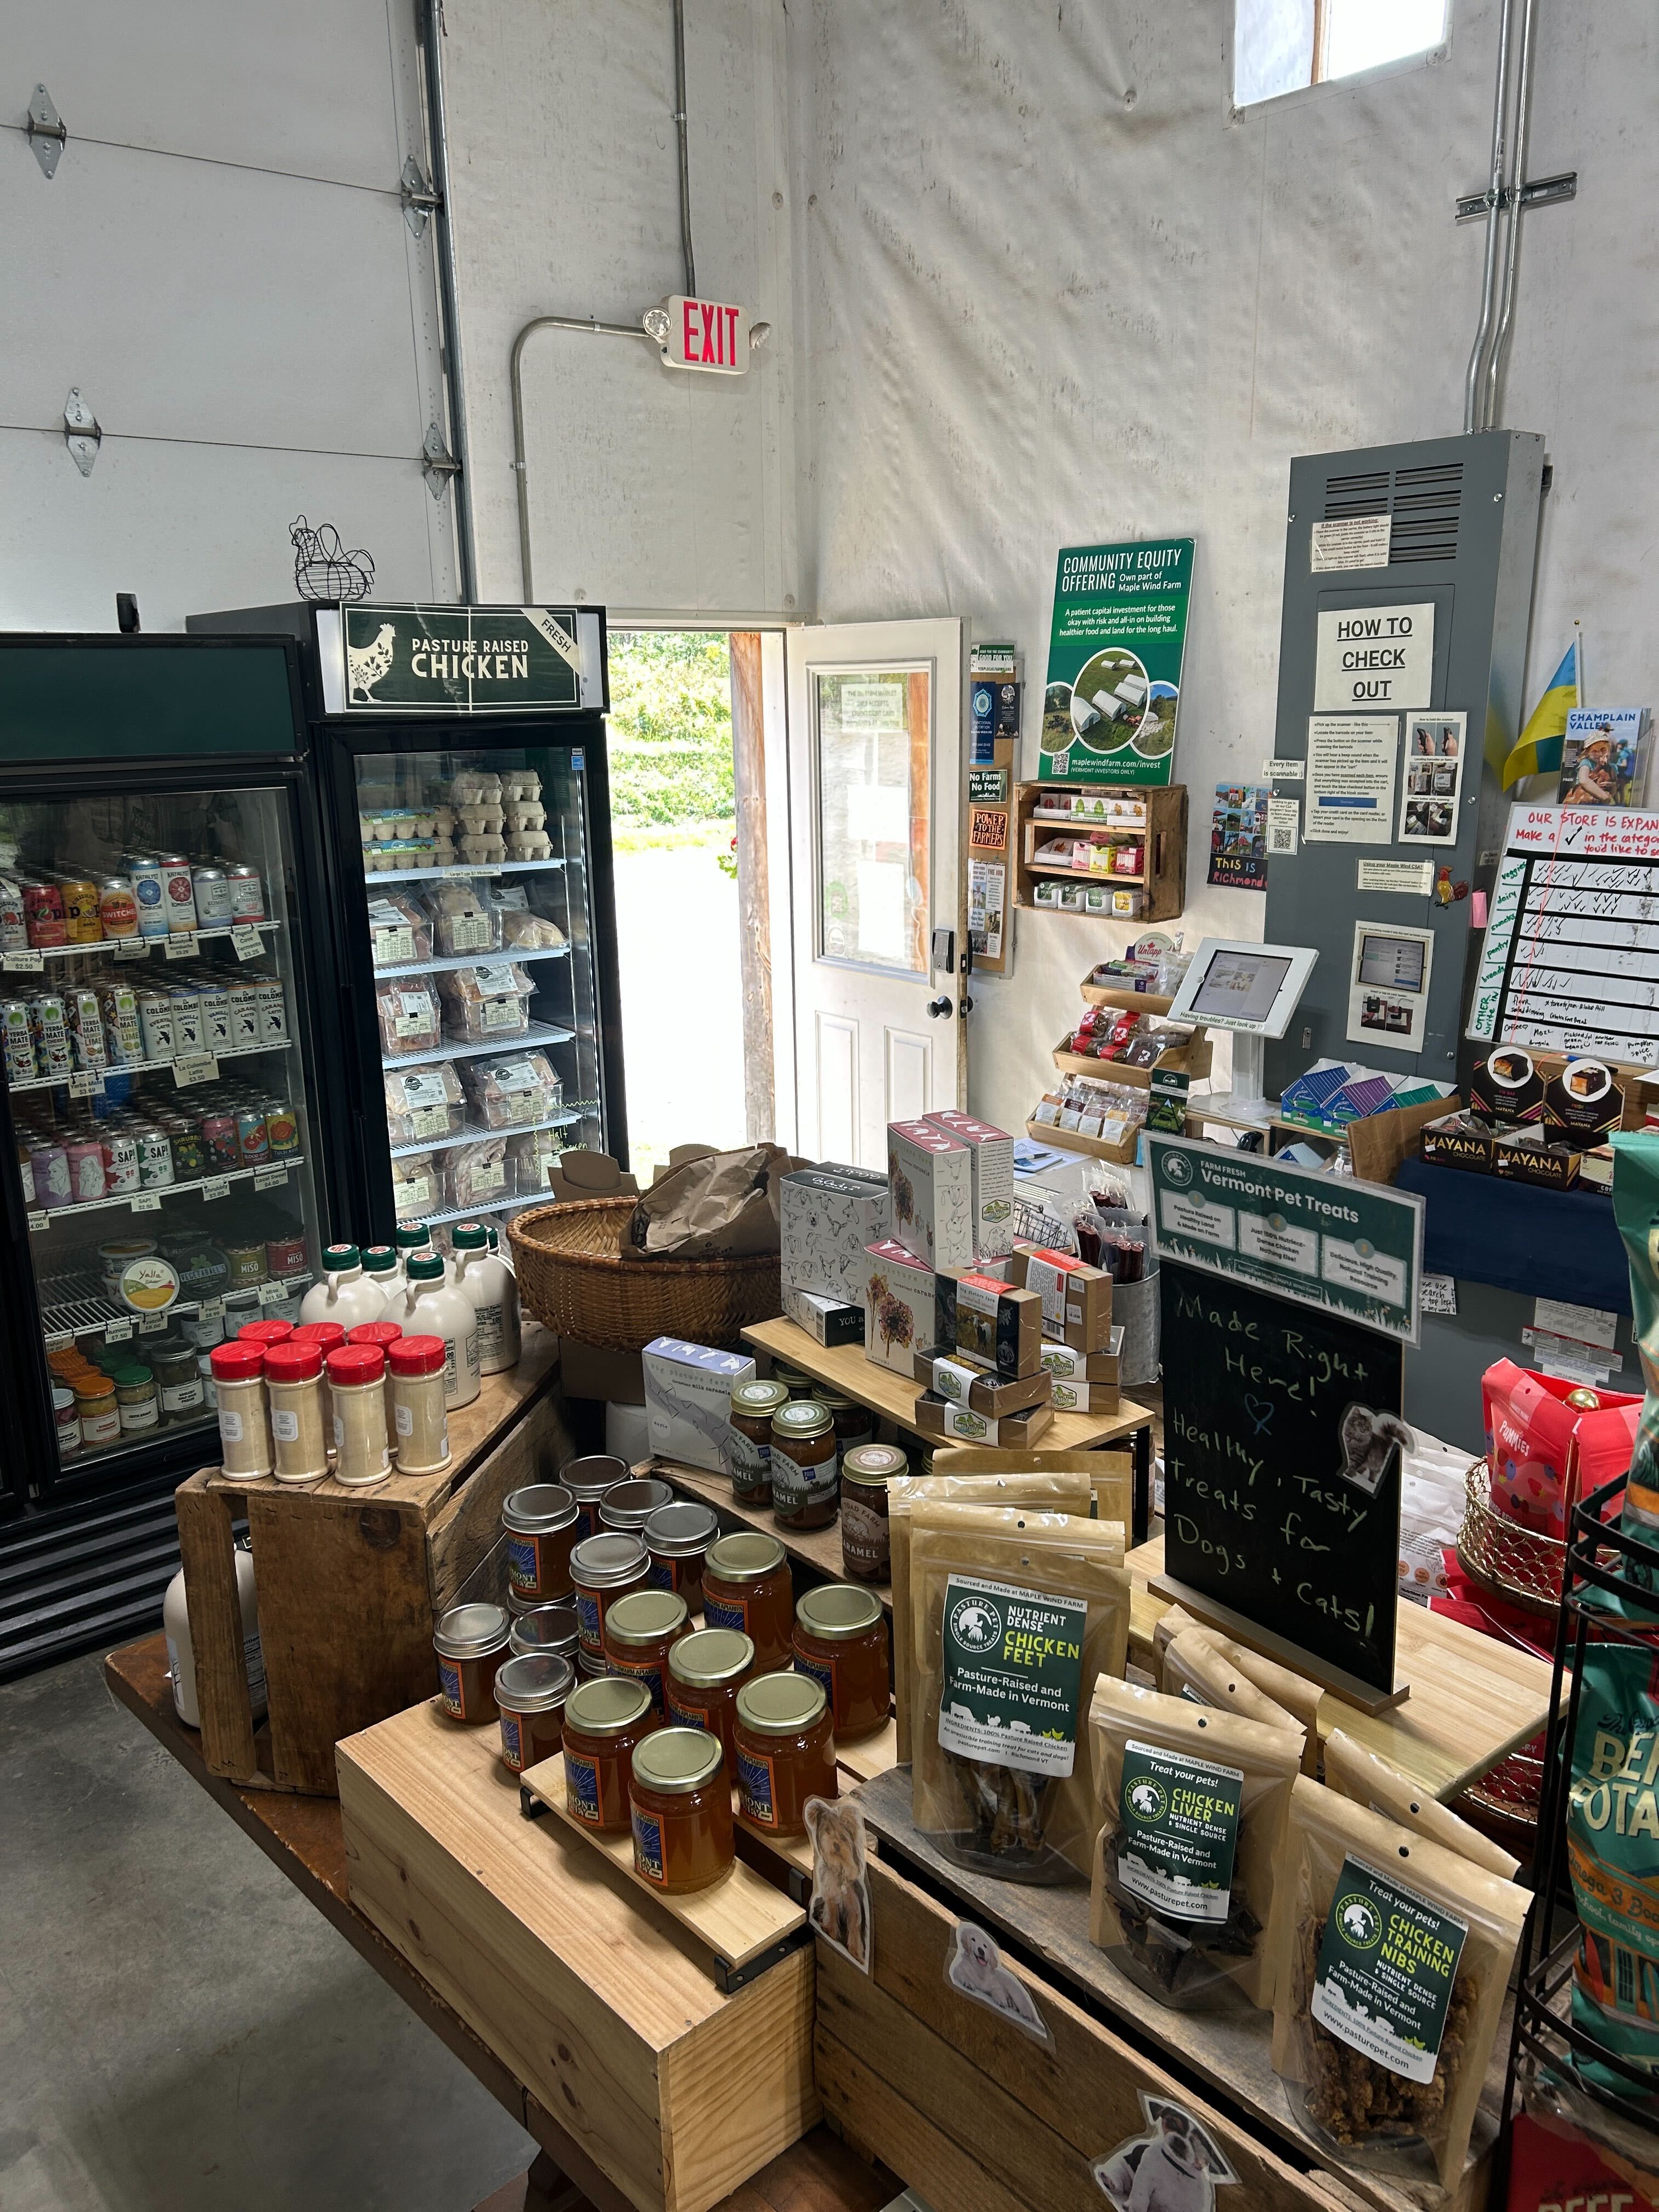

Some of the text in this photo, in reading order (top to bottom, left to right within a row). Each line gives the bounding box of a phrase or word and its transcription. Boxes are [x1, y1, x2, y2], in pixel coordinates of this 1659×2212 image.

[684, 301, 739, 366] EXIT
[1064, 549, 1182, 573] COMMUNITY EQUITY
[1062, 573, 1115, 592] OFFERING
[1138, 573, 1152, 582] part
[1154, 571, 1163, 579] of
[1119, 583, 1140, 592] Maple
[1068, 618, 1081, 627] okay
[1146, 614, 1170, 623] building
[1071, 608, 1091, 617] patient
[1092, 607, 1111, 616] capital
[541, 618, 571, 653] FRESH
[1148, 625, 1161, 634] long
[1338, 617, 1412, 638] HOW TO
[412, 639, 528, 653] PASTURE RAISED
[411, 654, 528, 679] CHICKEN
[1342, 648, 1406, 669] CHECK
[1353, 680, 1391, 698] OUT
[1072, 758, 1160, 769] maplewindfarm.com/invest
[982, 772, 1001, 781] Farms
[972, 782, 981, 791] No
[977, 813, 1004, 825] POWER
[978, 823, 1001, 833] TO THE
[1528, 811, 1553, 824] OUR
[1561, 812, 1599, 826] STORE
[1605, 816, 1616, 827] IS
[973, 831, 1003, 846] FARMERS
[1516, 829, 1542, 840] Make
[1549, 833, 1555, 843] a
[1599, 832, 1613, 842] the
[1611, 845, 1631, 855] like
[1635, 846, 1648, 855] to
[1246, 862, 1255, 873] IS
[1502, 862, 1527, 879] veggies
[1498, 890, 1517, 904] dairy
[1491, 913, 1516, 931] snacks
[1487, 939, 1509, 960] pantry
[1481, 966, 1505, 983] breads
[1180, 1011, 1198, 1020] Having
[1200, 1015, 1223, 1024] troubles?
[1475, 996, 1491, 1031] OTHER
[187, 1060, 211, 1069] Colombe
[173, 1135, 202, 1146] SHRUBBLY
[1425, 1134, 1486, 1155] MAYANA
[118, 1148, 136, 1163] SAP!
[150, 1145, 168, 1158] SAP!
[1453, 1152, 1487, 1162] CHOCOLATE
[1499, 1148, 1562, 1172] MAYANA
[1200, 1160, 1246, 1178] FARM FRESH
[1528, 1166, 1562, 1179] CHOCOLATE
[1201, 1169, 1359, 1223] Vermont Pet Treats
[241, 1263, 259, 1273] MISO
[287, 1254, 303, 1265] MISO
[139, 1269, 161, 1280] Yalla
[264, 1293, 283, 1301] $11.50
[838, 1316, 856, 1327] YOU
[106, 1327, 132, 1335] Hummus
[1175, 1290, 1368, 1383] Made Right
[1224, 1346, 1318, 1418] Here!
[1169, 1456, 1256, 1521] treats
[1292, 1475, 1368, 1533] Tasty
[844, 1502, 881, 1527] TOAD FARM
[1173, 1513, 1246, 1576] Dogs
[1296, 1581, 1375, 1649] Cats!
[1007, 1618, 1043, 1632] DENSE
[1008, 1606, 1066, 1626] NUTRIENT
[1005, 1630, 1080, 1659] CHICKEN
[1003, 1646, 1046, 1667] FEET
[957, 1667, 1062, 1697] Pasture-Raised and
[950, 1676, 1070, 1712] Farm-Made in Vermont
[1150, 1761, 1218, 1787] Treat your pets!
[1171, 1800, 1211, 1822] LIVER
[1173, 1788, 1234, 1816] CHICKEN
[1169, 1813, 1227, 1834] NUTRIENT DENSE
[1175, 1822, 1198, 1834] SINGLE
[1200, 1829, 1226, 1841] SOURCE
[1128, 1837, 1216, 1869] Farm-Made in Vermont
[1137, 1830, 1210, 1858] Pasture-Raised and
[1132, 1877, 1207, 1910] www.pasturepet.com
[1612, 1887, 1623, 1905] 3
[1369, 1880, 1440, 1931] Treat your pets!
[1390, 1914, 1454, 1963] CHICKEN
[1381, 1943, 1417, 1974] NIBS
[1387, 1927, 1449, 1977] TRAINING
[1324, 2010, 1409, 2069] www.pasturepet.com
